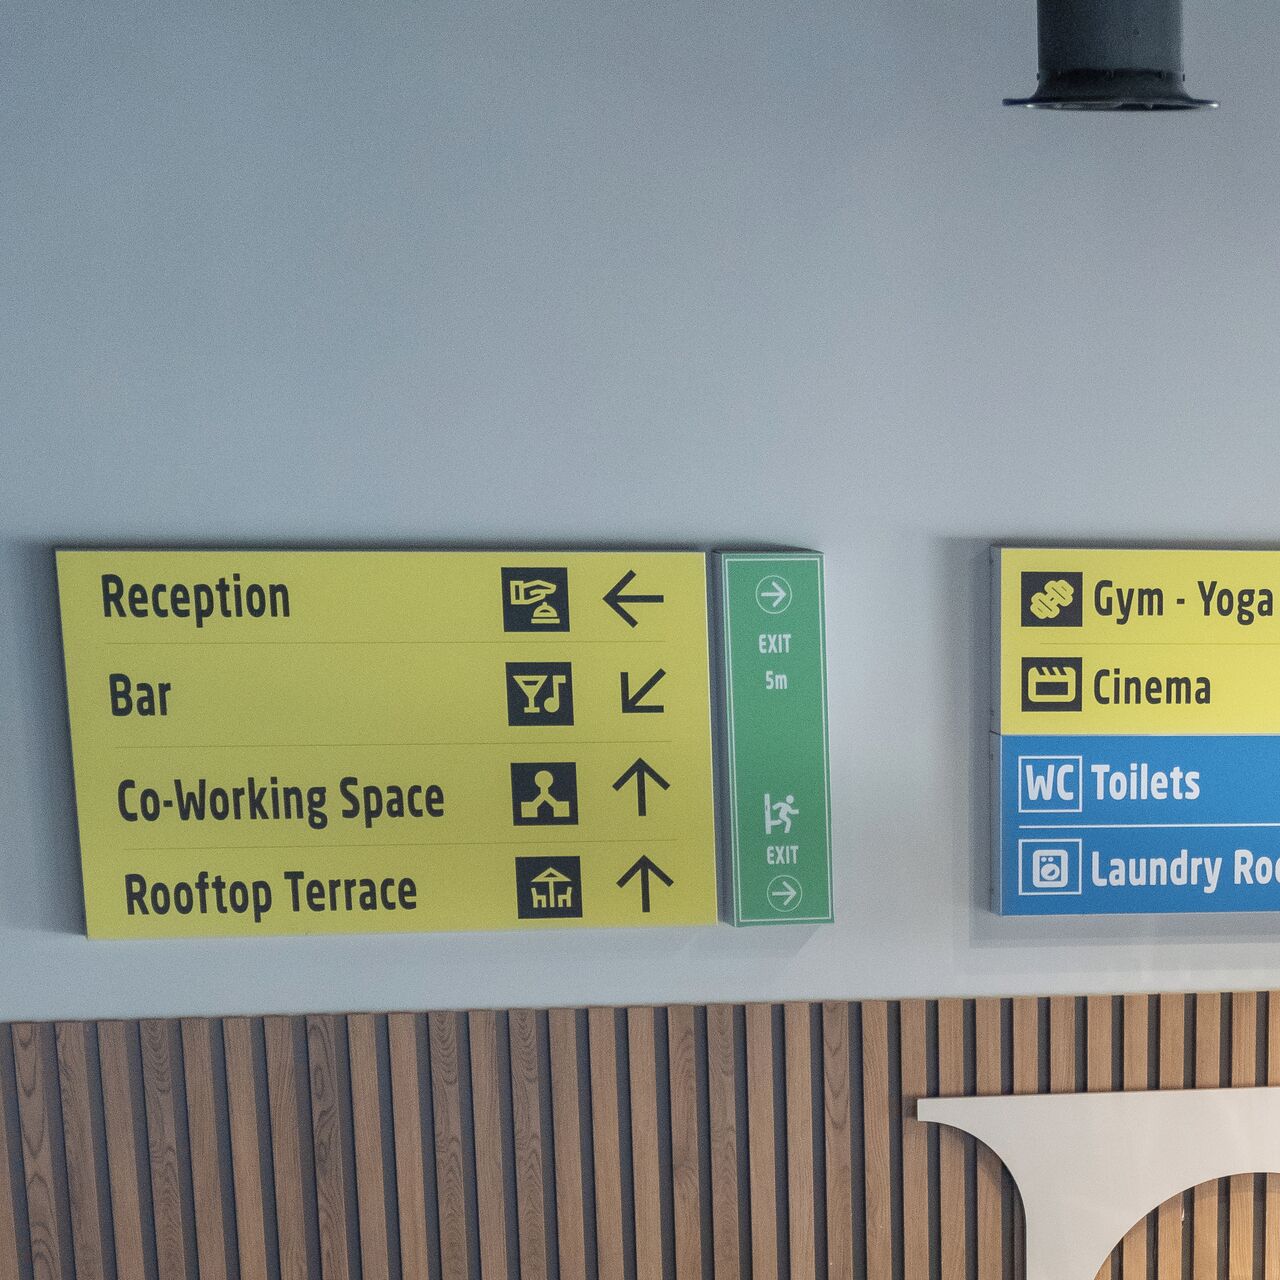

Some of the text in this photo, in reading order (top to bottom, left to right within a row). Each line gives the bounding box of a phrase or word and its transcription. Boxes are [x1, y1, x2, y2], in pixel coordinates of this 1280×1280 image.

[102, 573, 291, 627] Reception
[1094, 580, 1165, 624] Gym
[1198, 580, 1274, 625] Yoga
[758, 633, 791, 654] EXIT
[109, 673, 171, 717] Bar
[764, 671, 789, 691] 5m
[1093, 669, 1212, 704] Cinema
[117, 777, 445, 829] Co-Working Space
[1026, 763, 1201, 801] WC Toilets
[766, 844, 799, 865] EXIT
[1092, 850, 1222, 893] Laundry
[125, 869, 417, 922] Rooftop Terrace
